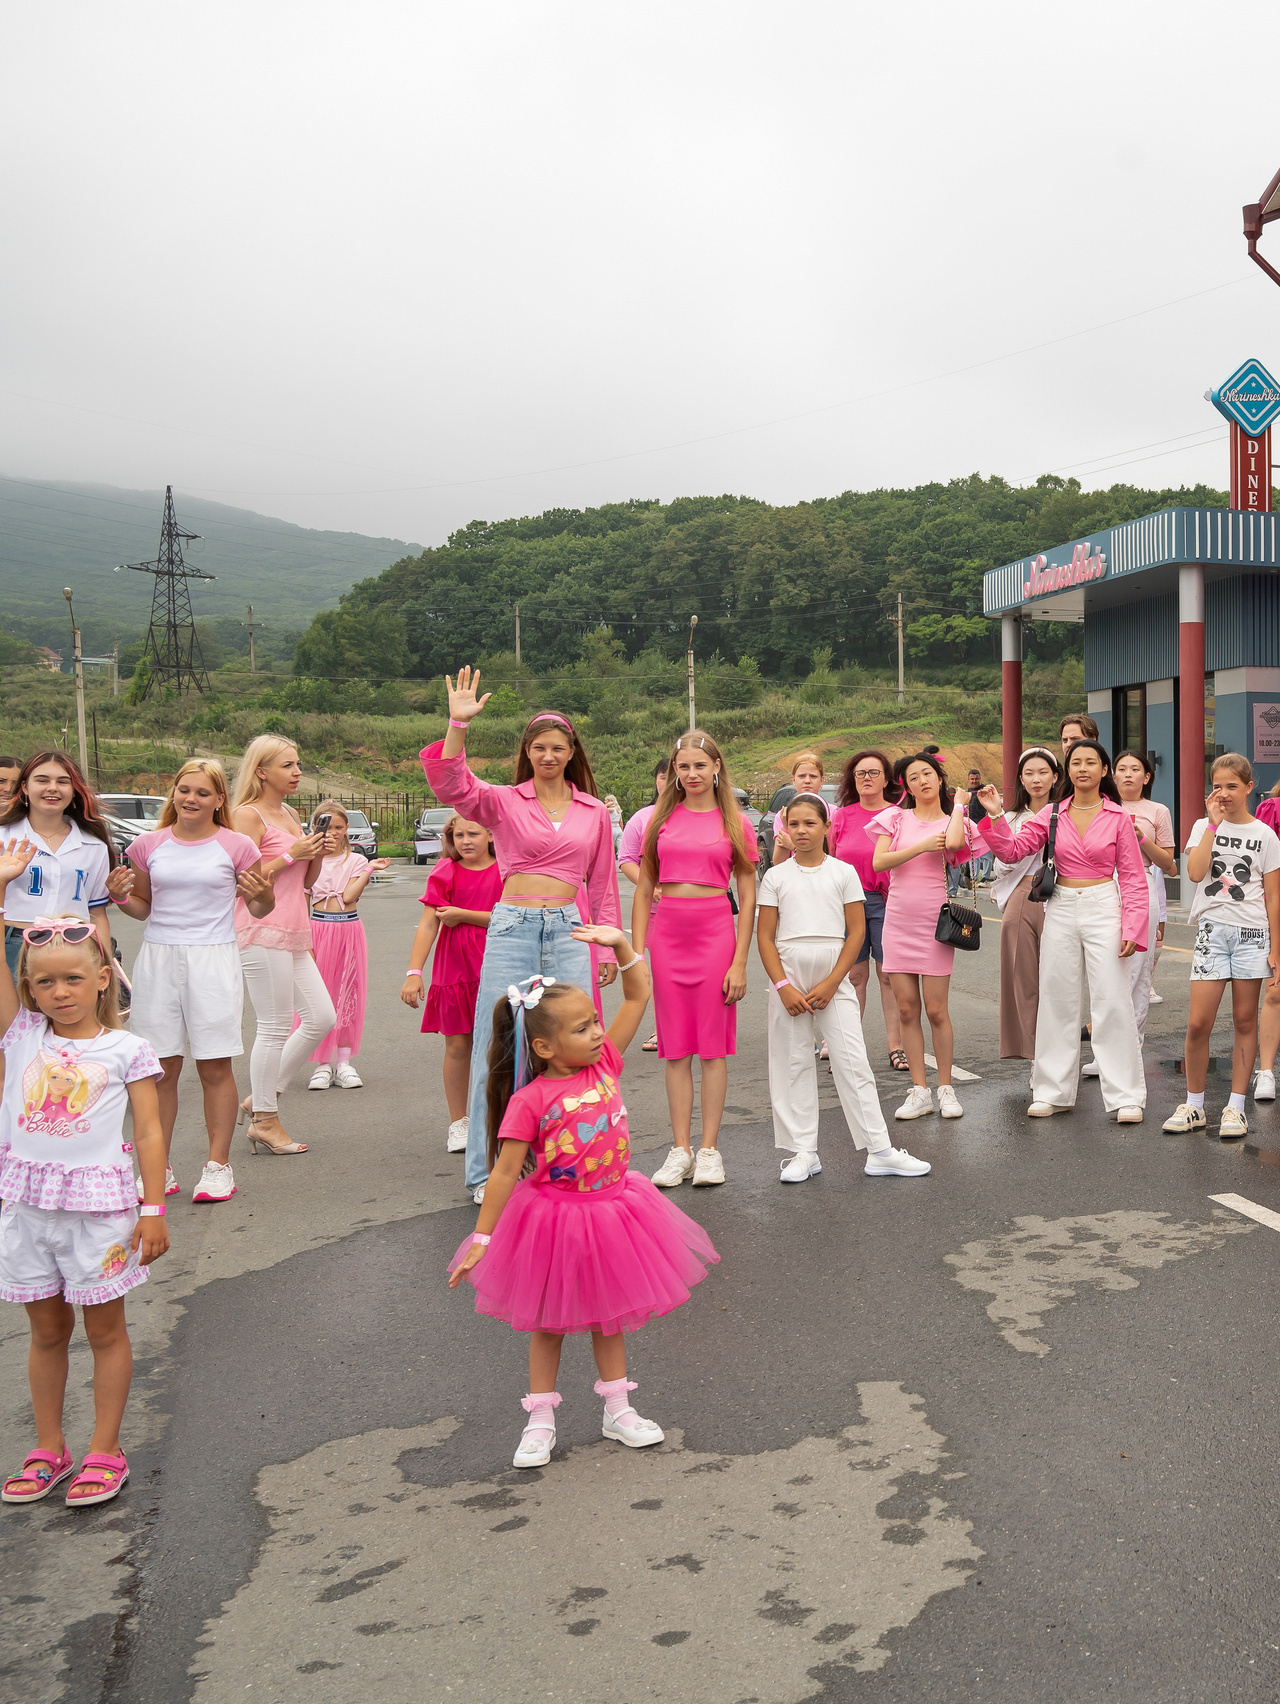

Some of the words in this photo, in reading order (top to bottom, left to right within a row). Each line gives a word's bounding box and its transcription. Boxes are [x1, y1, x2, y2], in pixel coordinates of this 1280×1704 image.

[1247, 440, 1259, 512] DINE
[1024, 542, 1107, 599] Narineshka's
[1214, 834, 1242, 850] OR
[1245, 839, 1262, 852] U!
[28, 865, 43, 896] 1
[26, 1110, 74, 1138] Barbie
